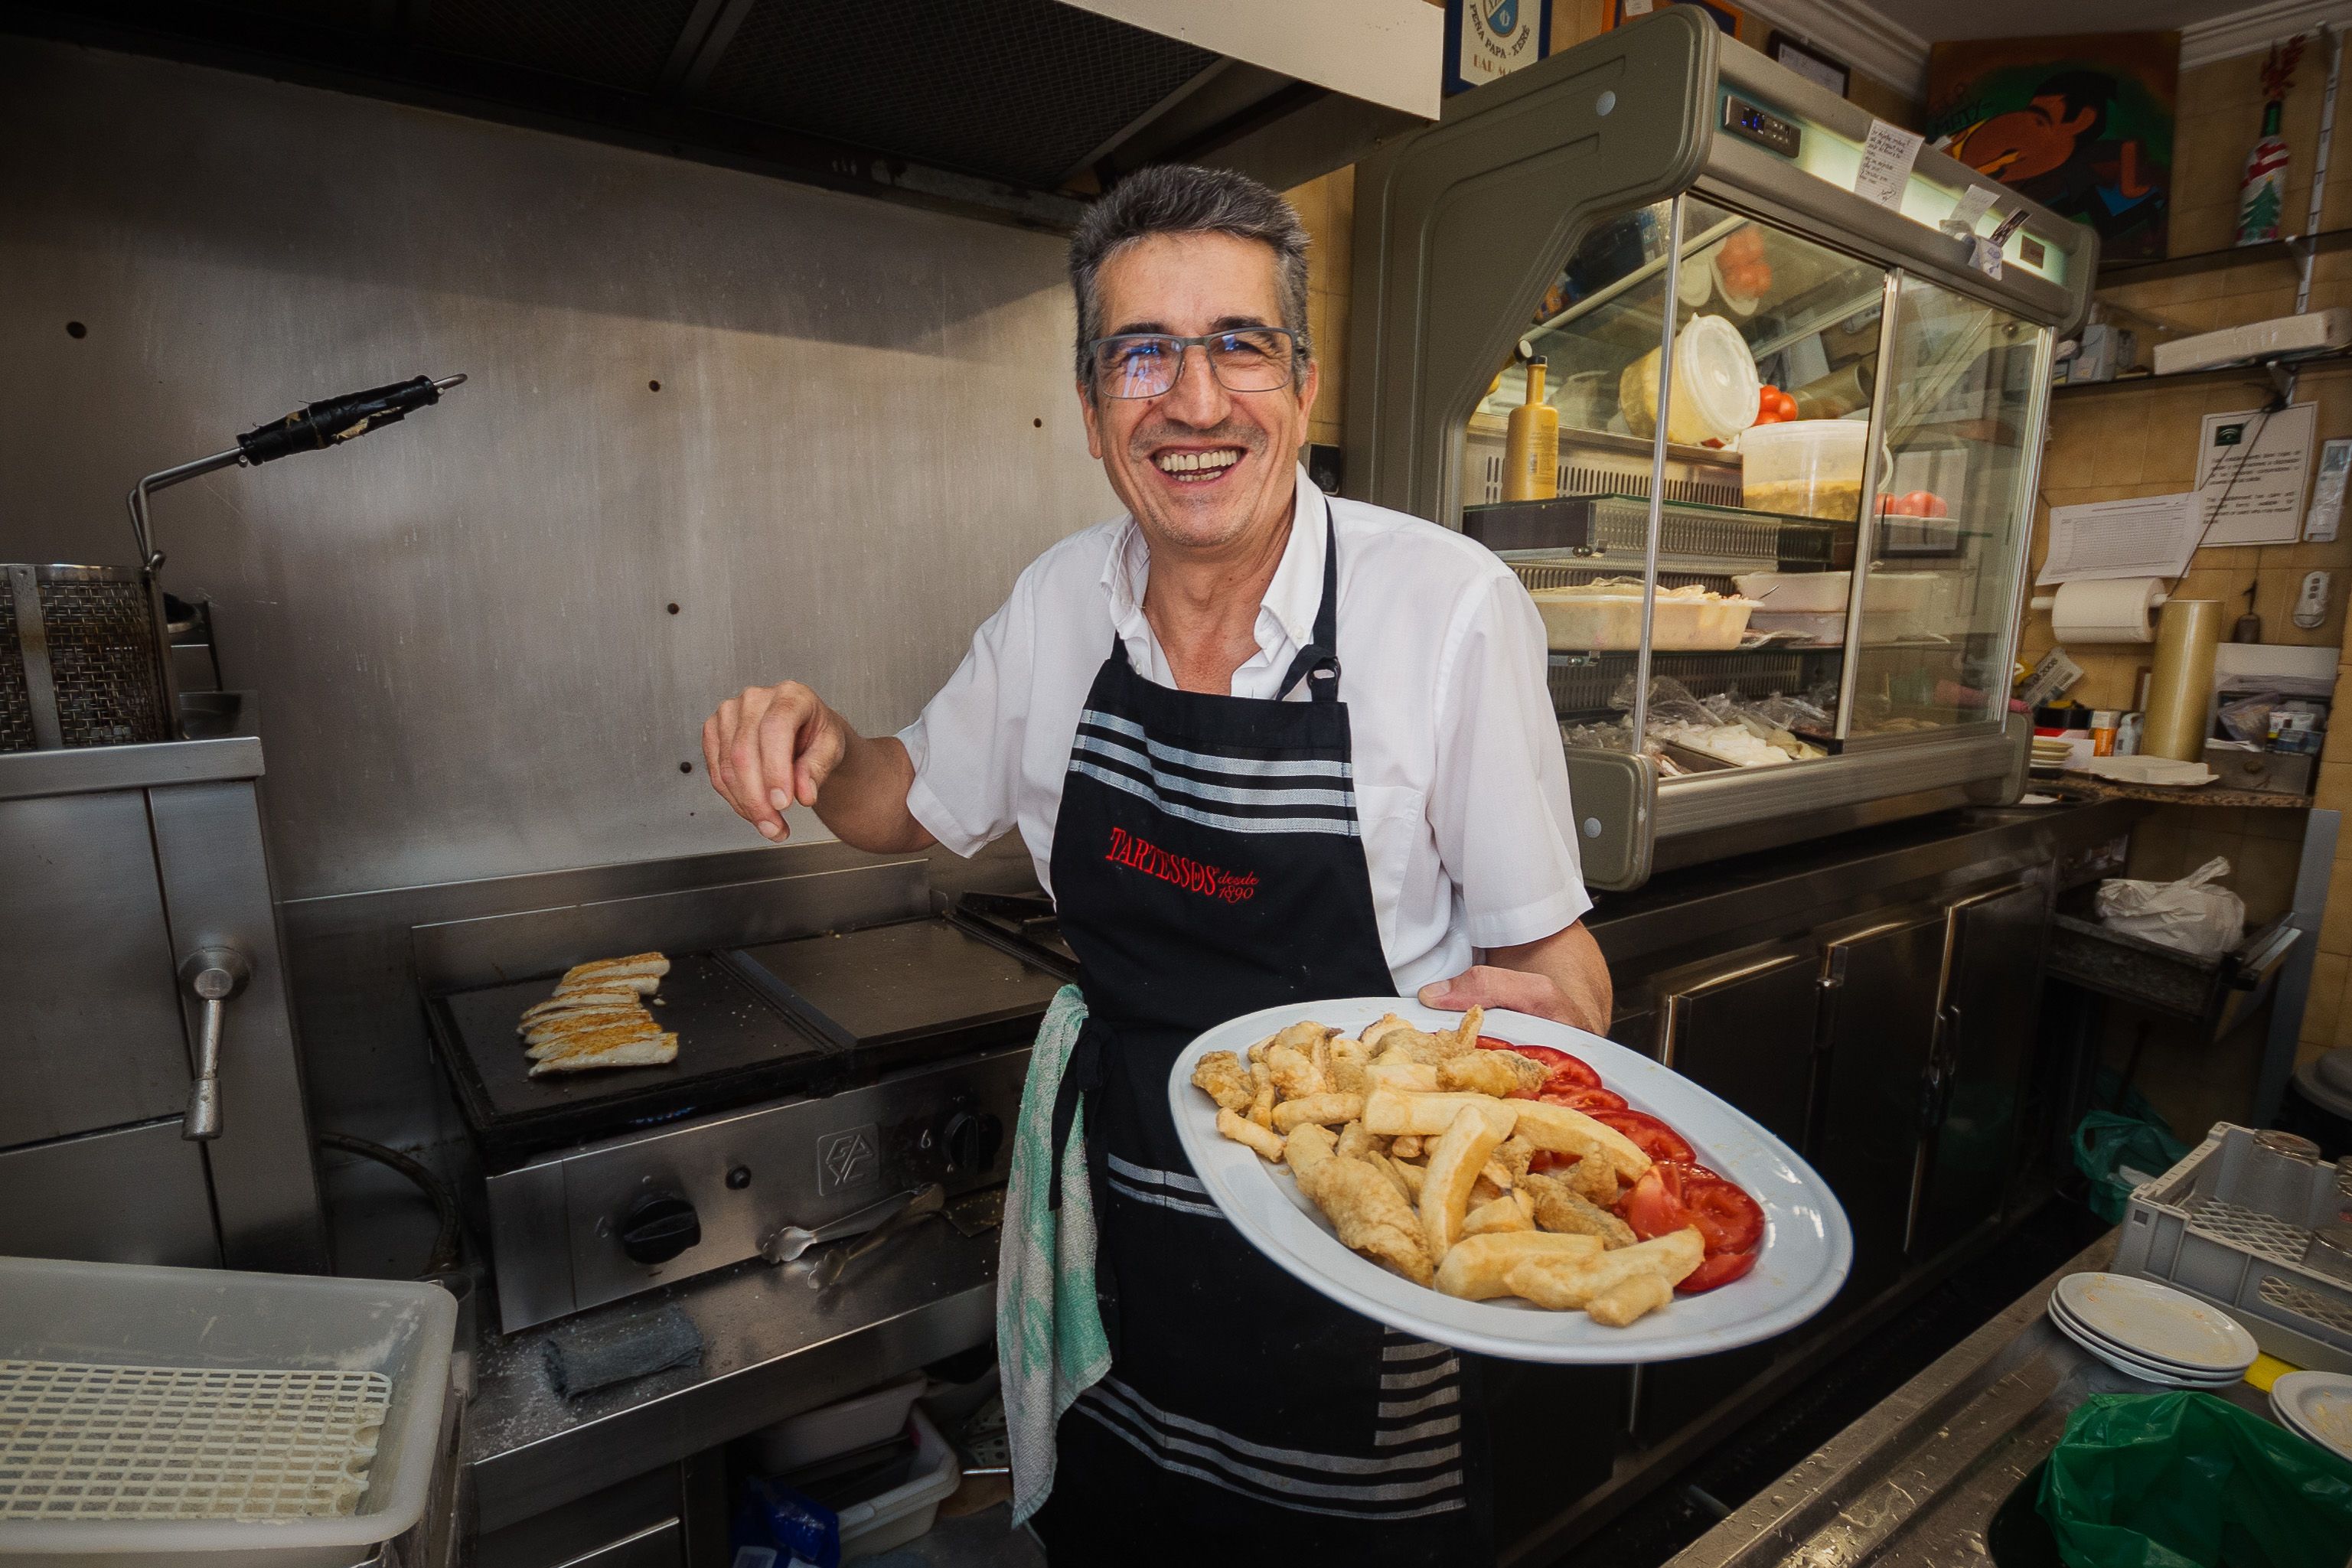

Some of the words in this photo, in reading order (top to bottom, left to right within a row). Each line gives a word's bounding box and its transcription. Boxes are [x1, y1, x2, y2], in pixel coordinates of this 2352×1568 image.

[1485, 37, 1506, 59] PAPA
[1105, 826, 1216, 895] TARTESSOS
[1218, 871, 1259, 885] desde
[1218, 885, 1254, 904] 1890
